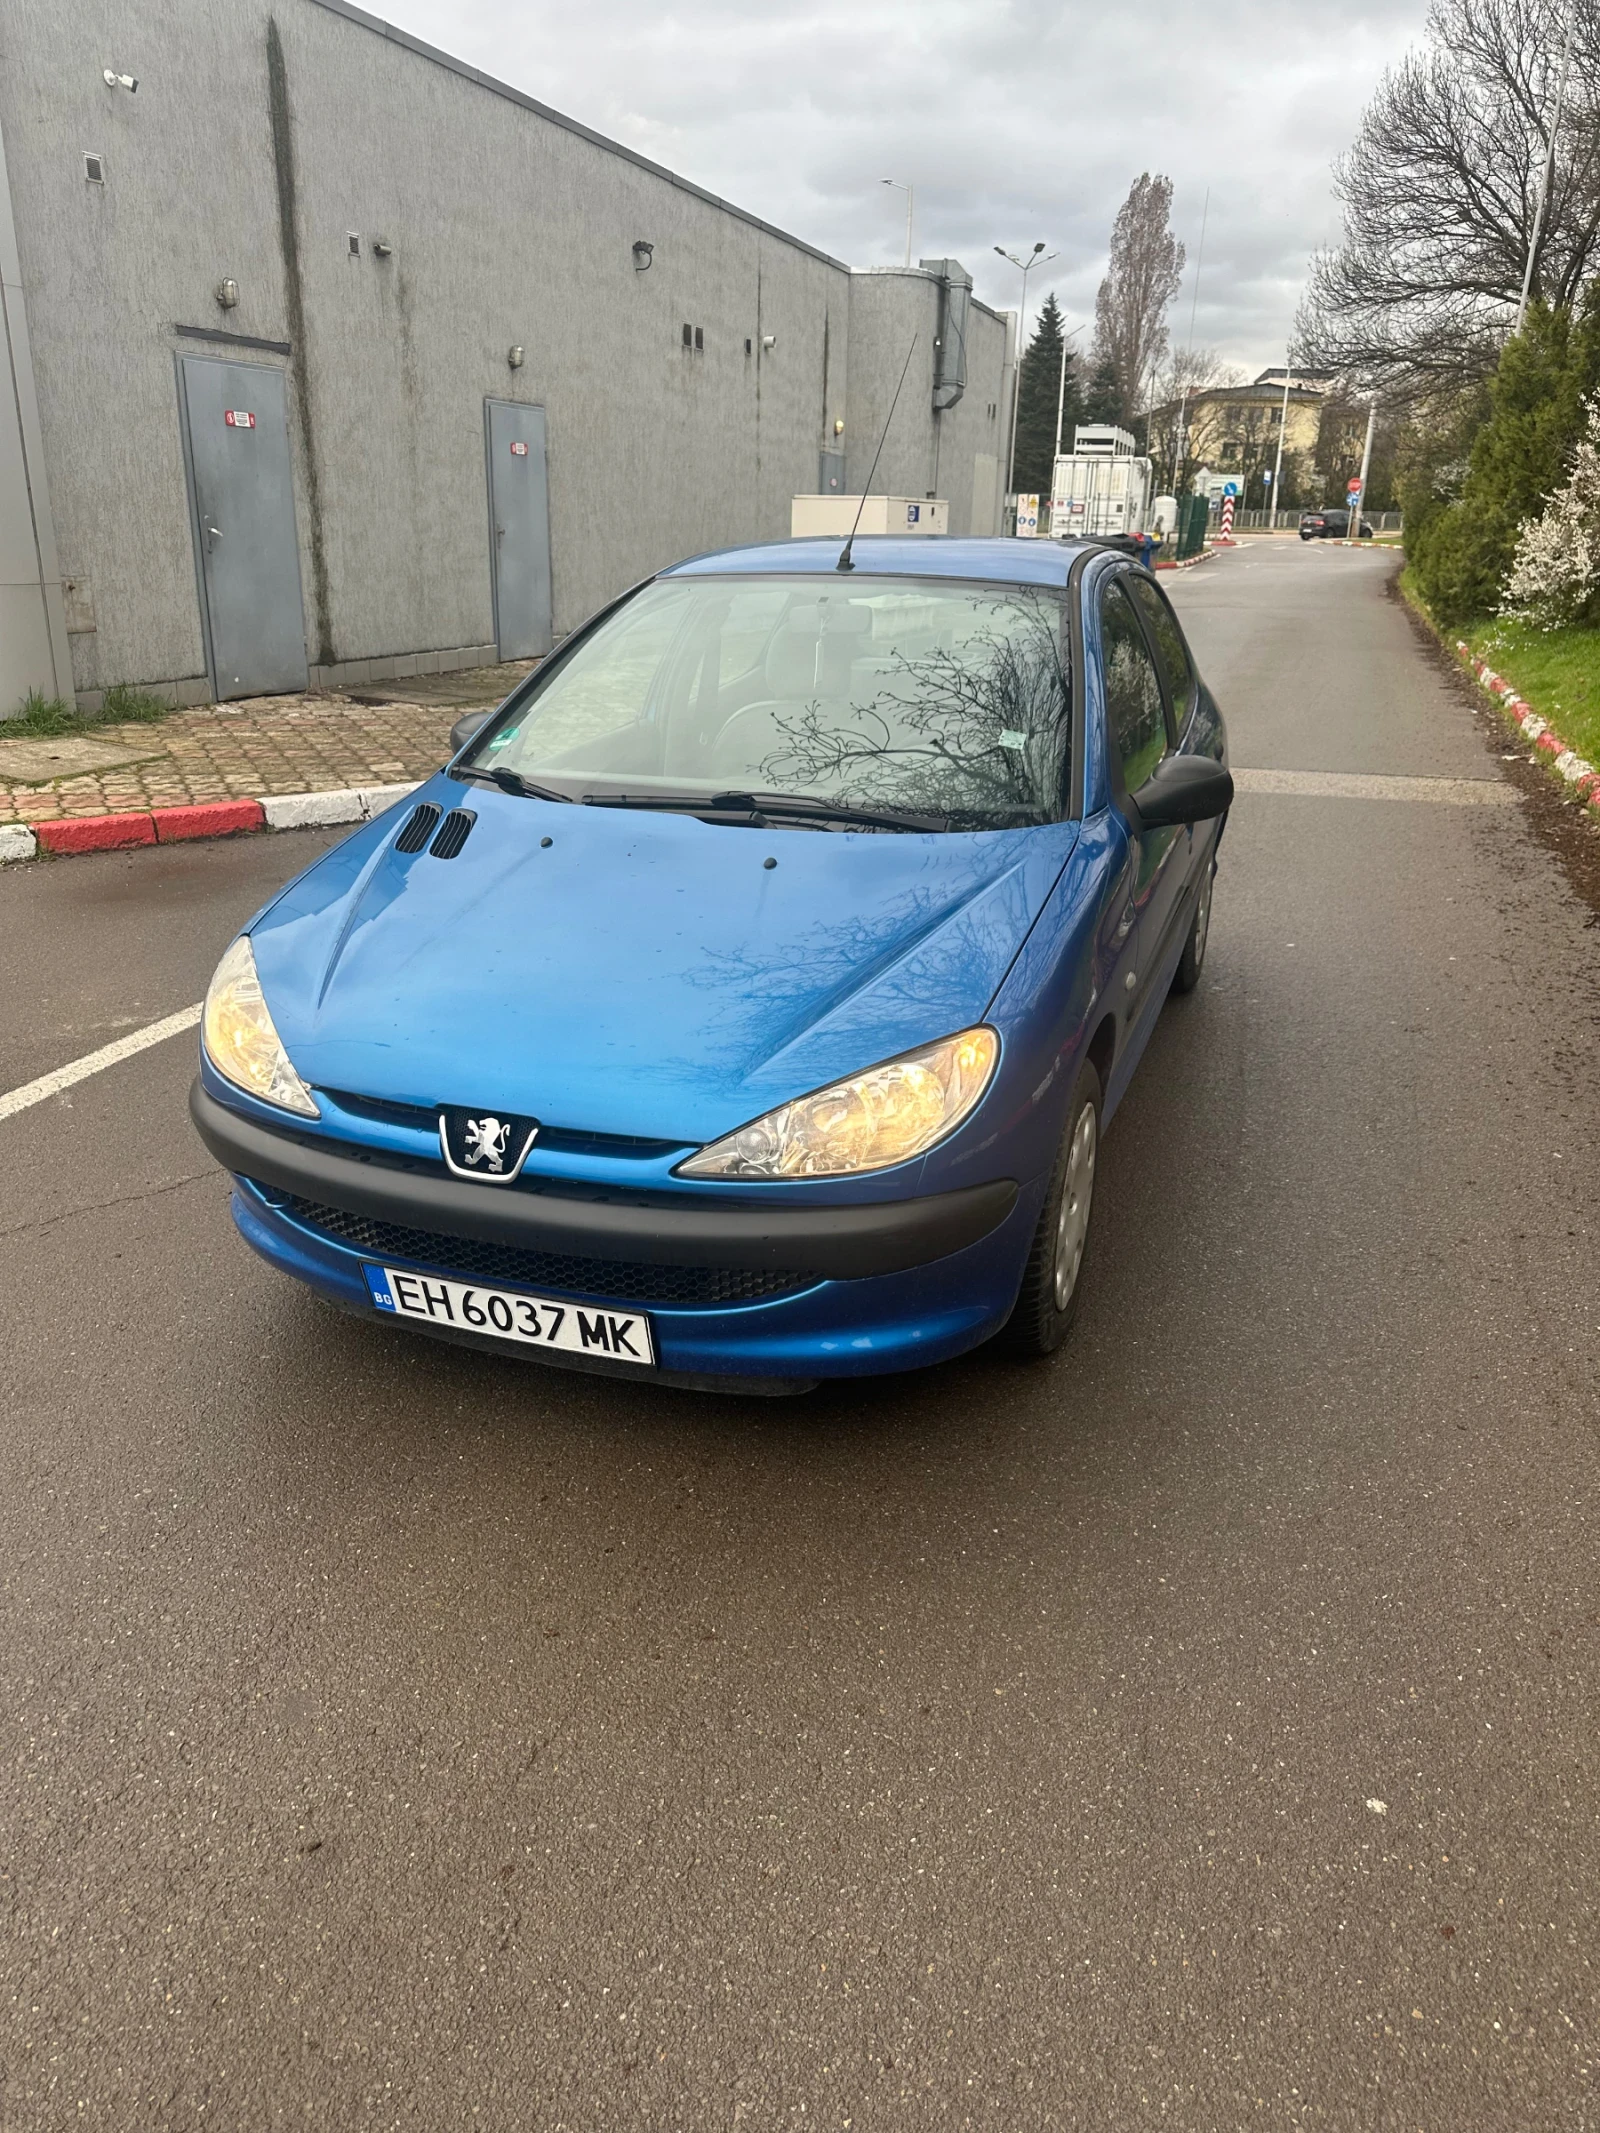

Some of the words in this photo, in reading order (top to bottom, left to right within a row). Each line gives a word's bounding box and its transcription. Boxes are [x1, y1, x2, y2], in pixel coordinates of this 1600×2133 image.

[374, 1291, 392, 1305] BG
[392, 1274, 454, 1320] EH
[461, 1290, 565, 1341] 6037
[577, 1310, 641, 1357] MK
